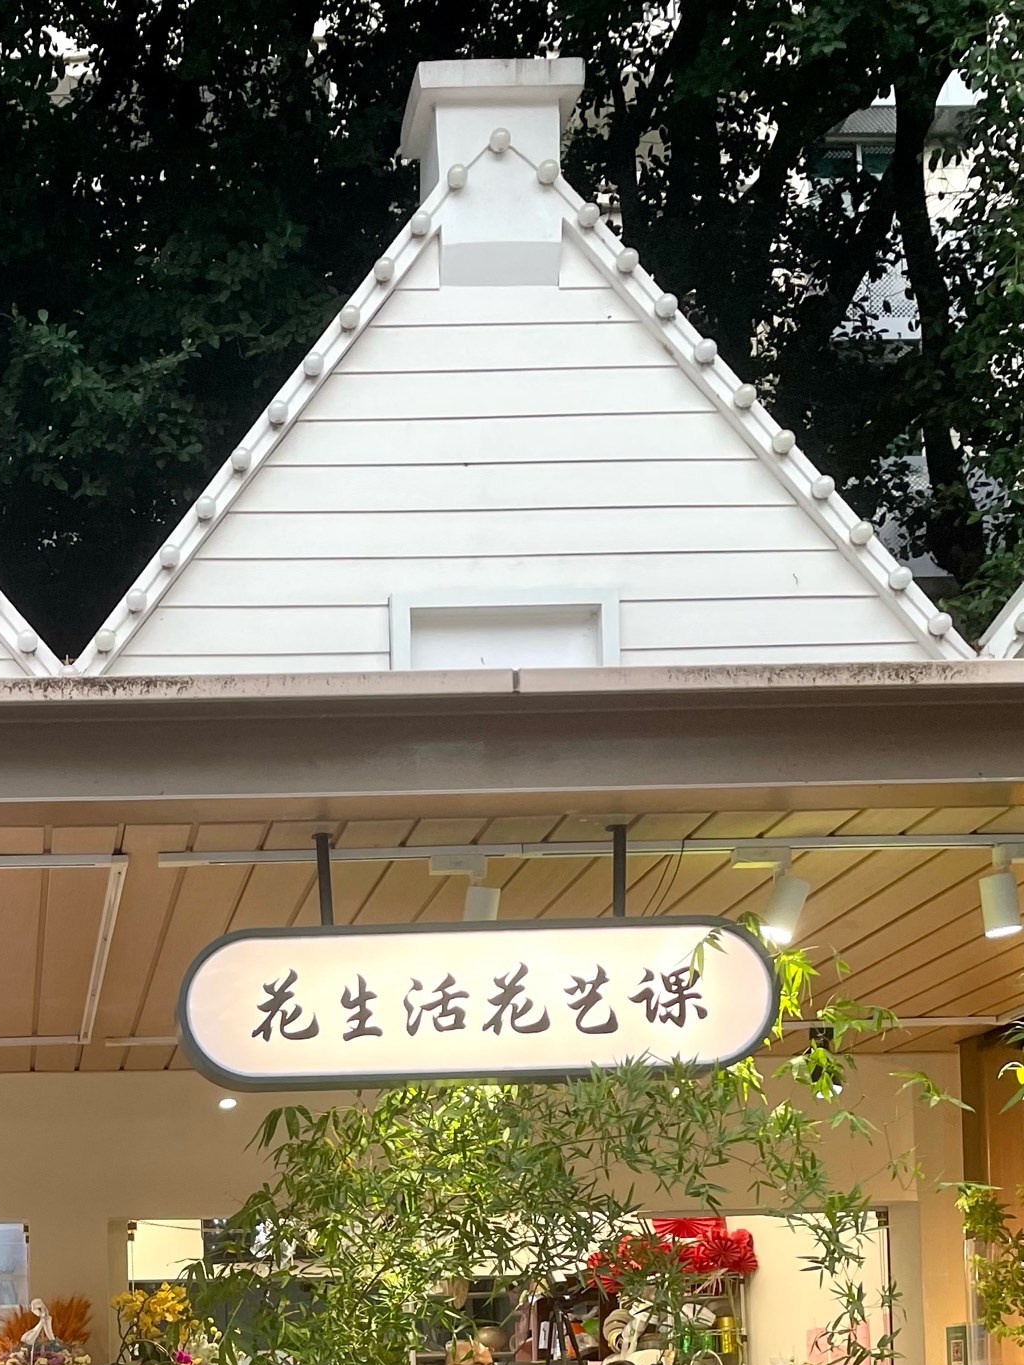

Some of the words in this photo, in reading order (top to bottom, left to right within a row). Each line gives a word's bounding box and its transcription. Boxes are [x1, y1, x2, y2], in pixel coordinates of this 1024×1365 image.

[252, 961, 709, 1042] 花生活花艺课
